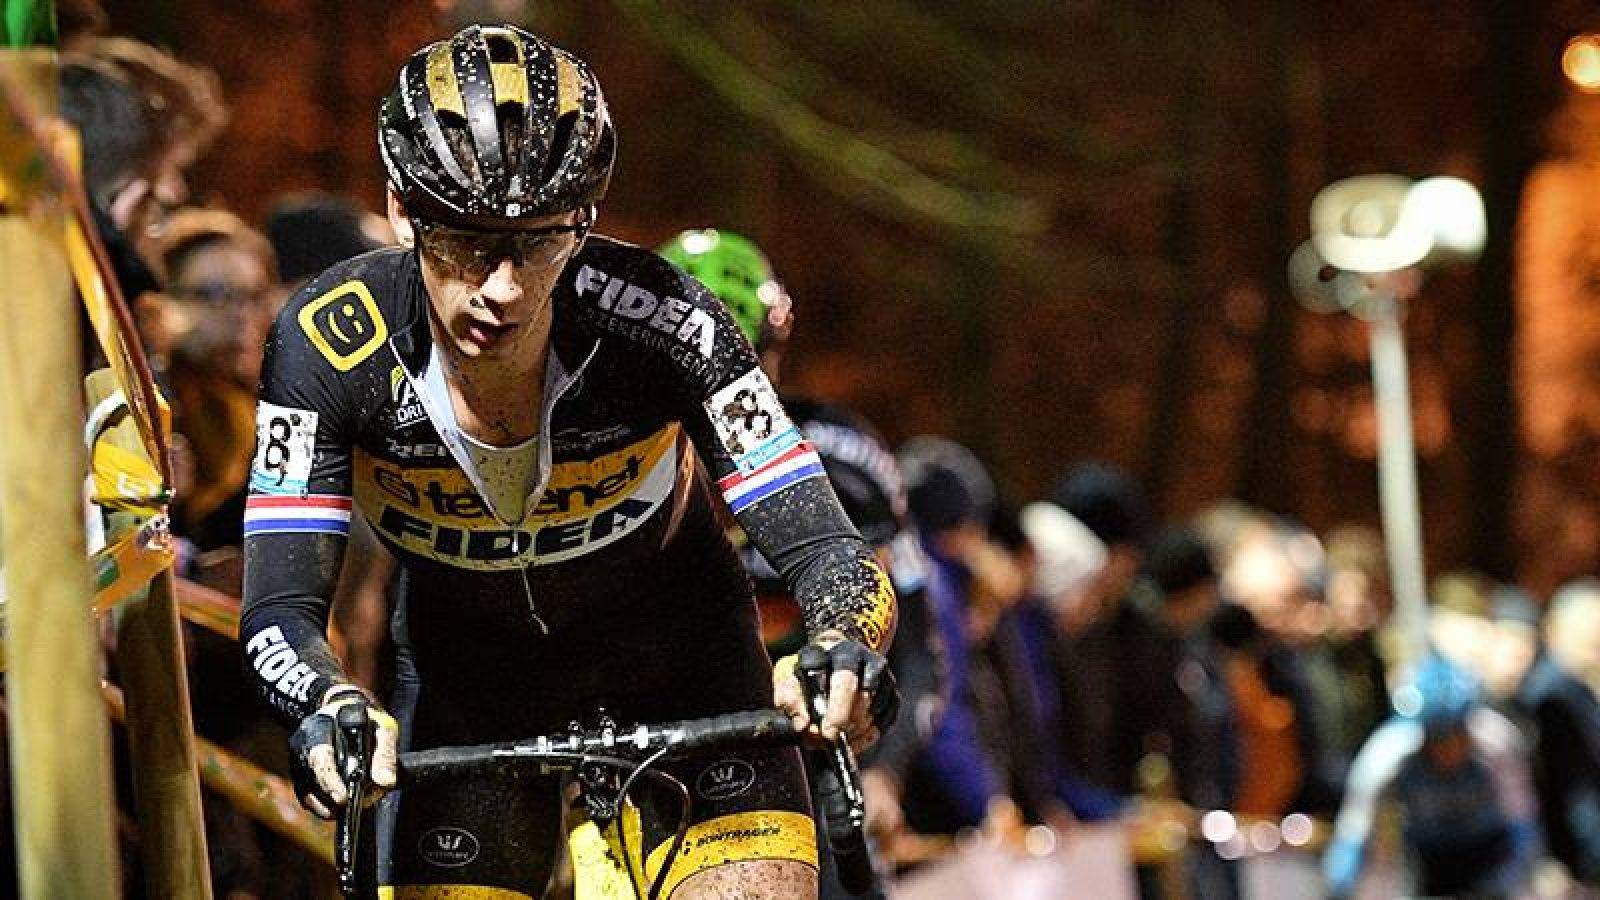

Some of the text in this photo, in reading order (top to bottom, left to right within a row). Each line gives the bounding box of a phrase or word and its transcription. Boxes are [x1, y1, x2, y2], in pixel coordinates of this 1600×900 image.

[575, 264, 716, 360] FIDEA
[265, 416, 291, 470] 8
[426, 455, 647, 518] teenet
[380, 498, 656, 561] FIDEA
[246, 625, 321, 703] FIDEA
